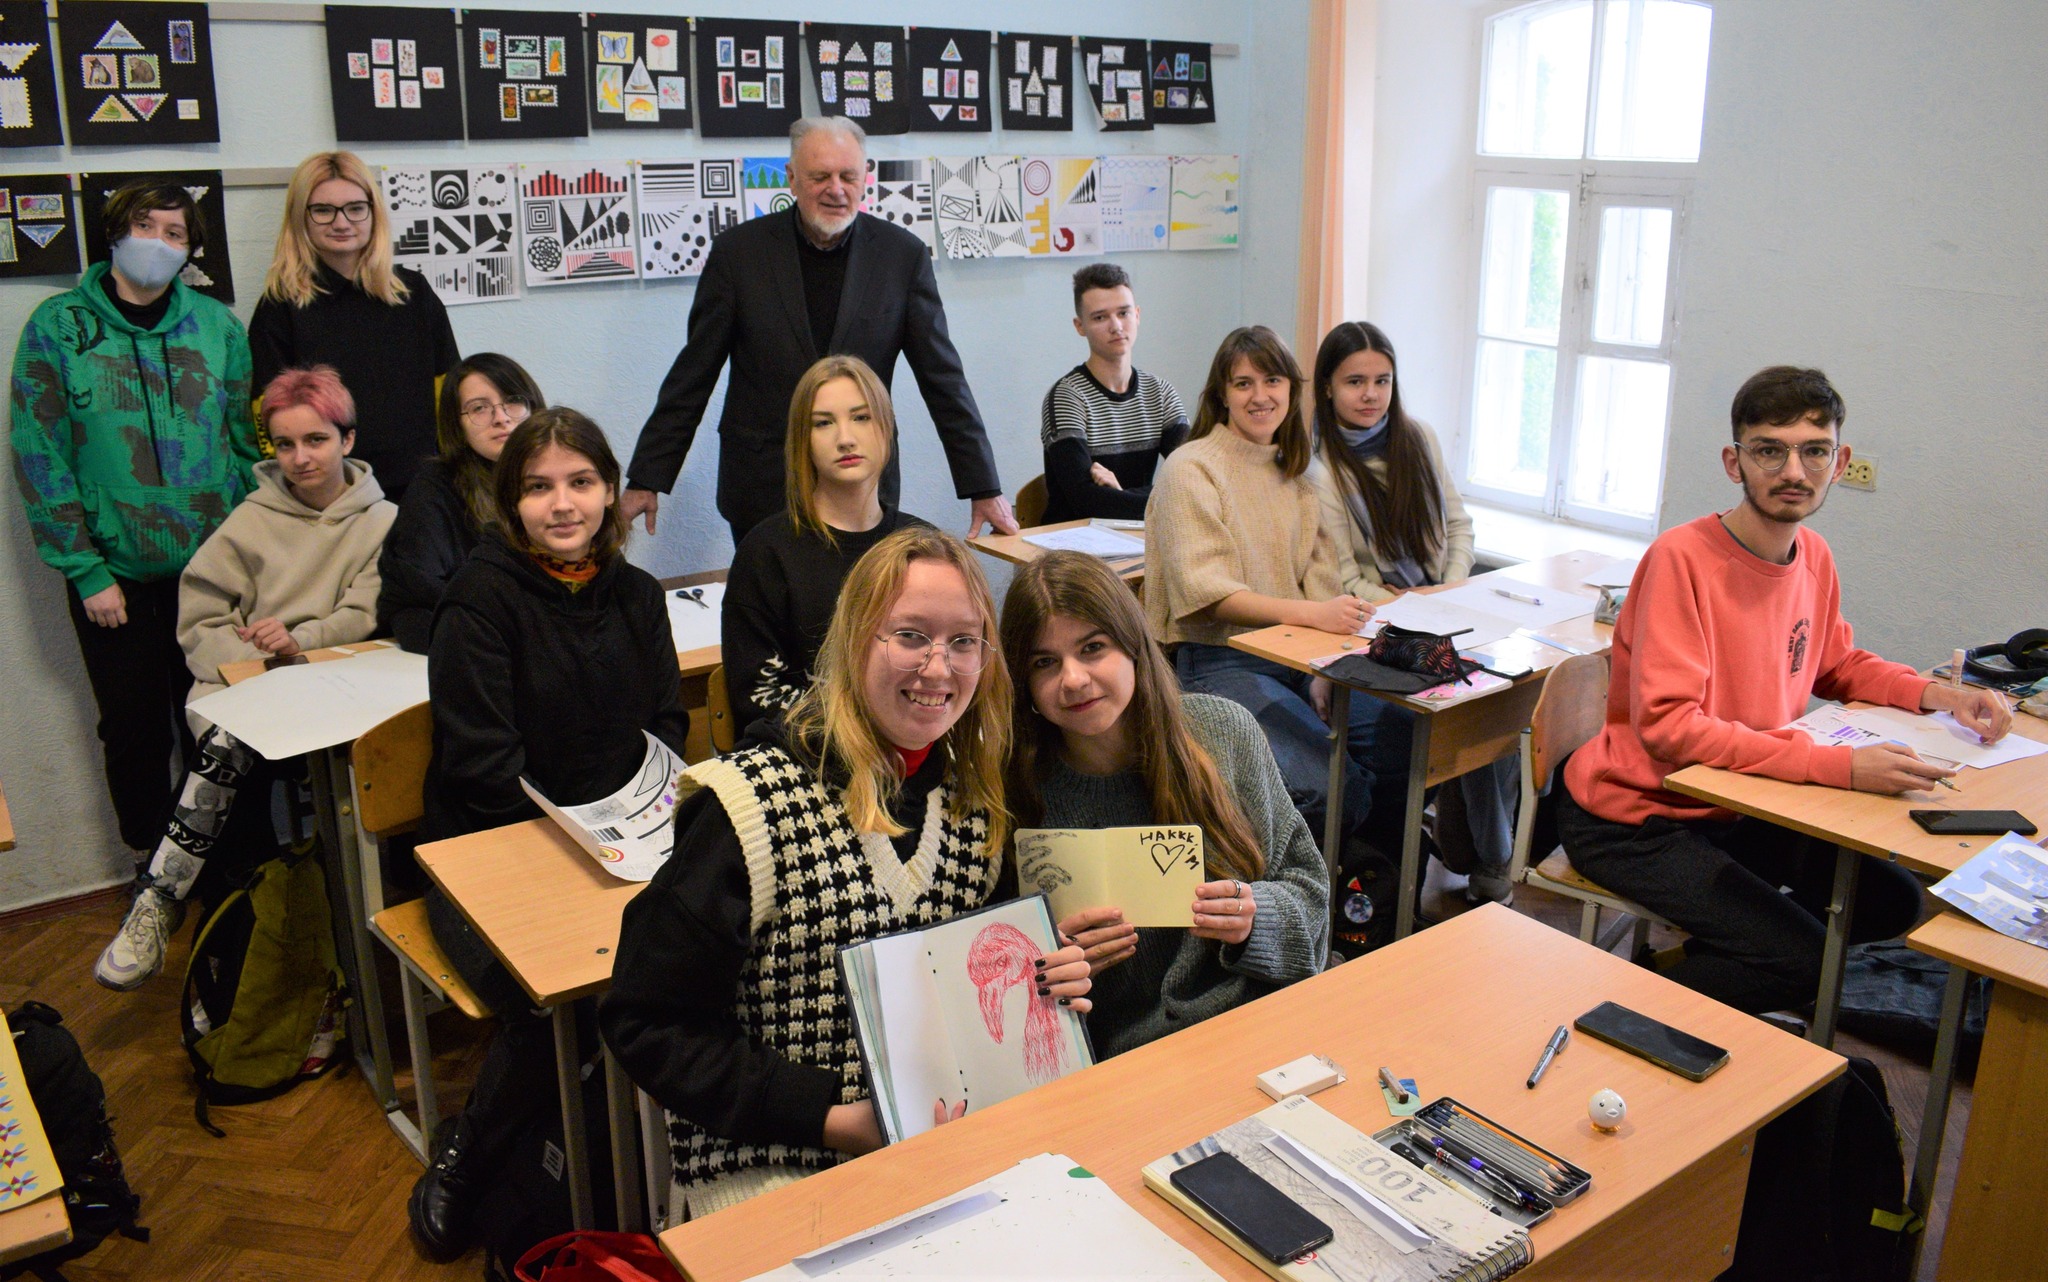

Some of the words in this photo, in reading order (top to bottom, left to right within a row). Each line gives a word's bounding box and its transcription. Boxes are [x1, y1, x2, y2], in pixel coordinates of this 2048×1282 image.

[168, 821, 214, 853] サンジ
[1356, 1156, 1437, 1203] 100
